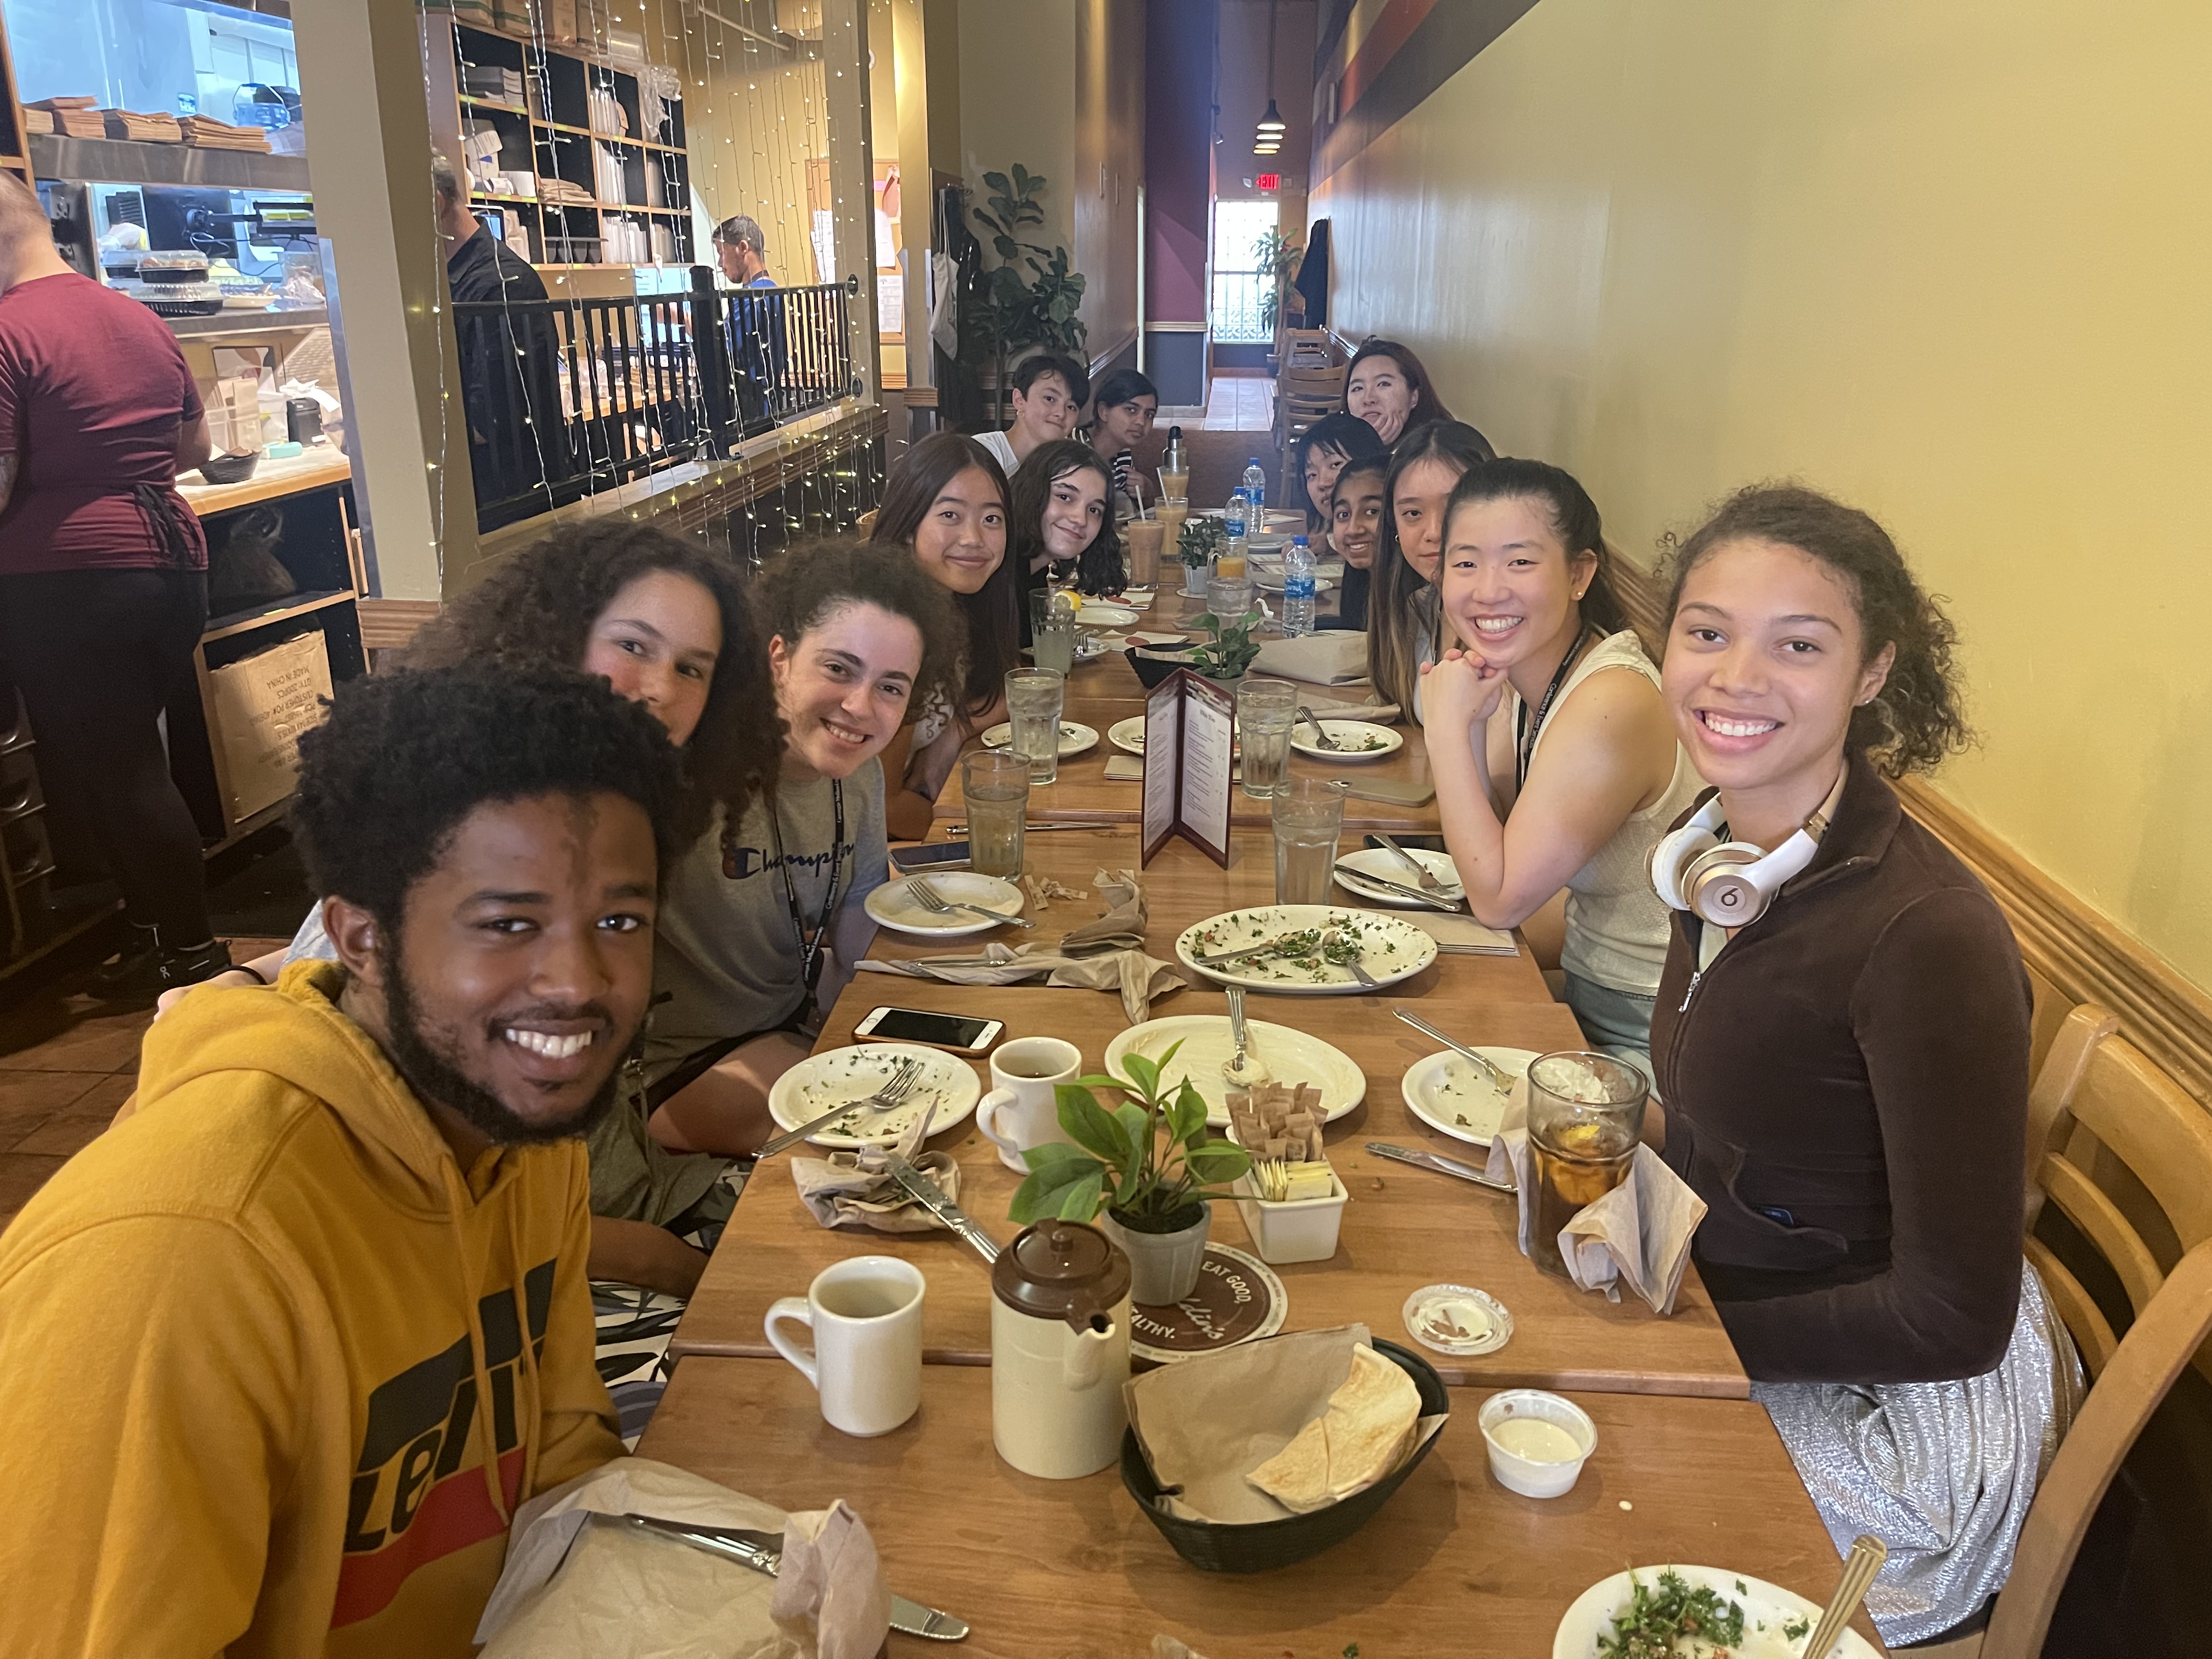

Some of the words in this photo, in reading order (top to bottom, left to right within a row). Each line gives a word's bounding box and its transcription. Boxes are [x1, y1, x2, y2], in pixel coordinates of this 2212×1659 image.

[1261, 175, 1279, 189] EXIT
[722, 843, 854, 879] Champn
[1201, 1261, 1232, 1276] EAT
[1226, 1275, 1252, 1304] GOOD,
